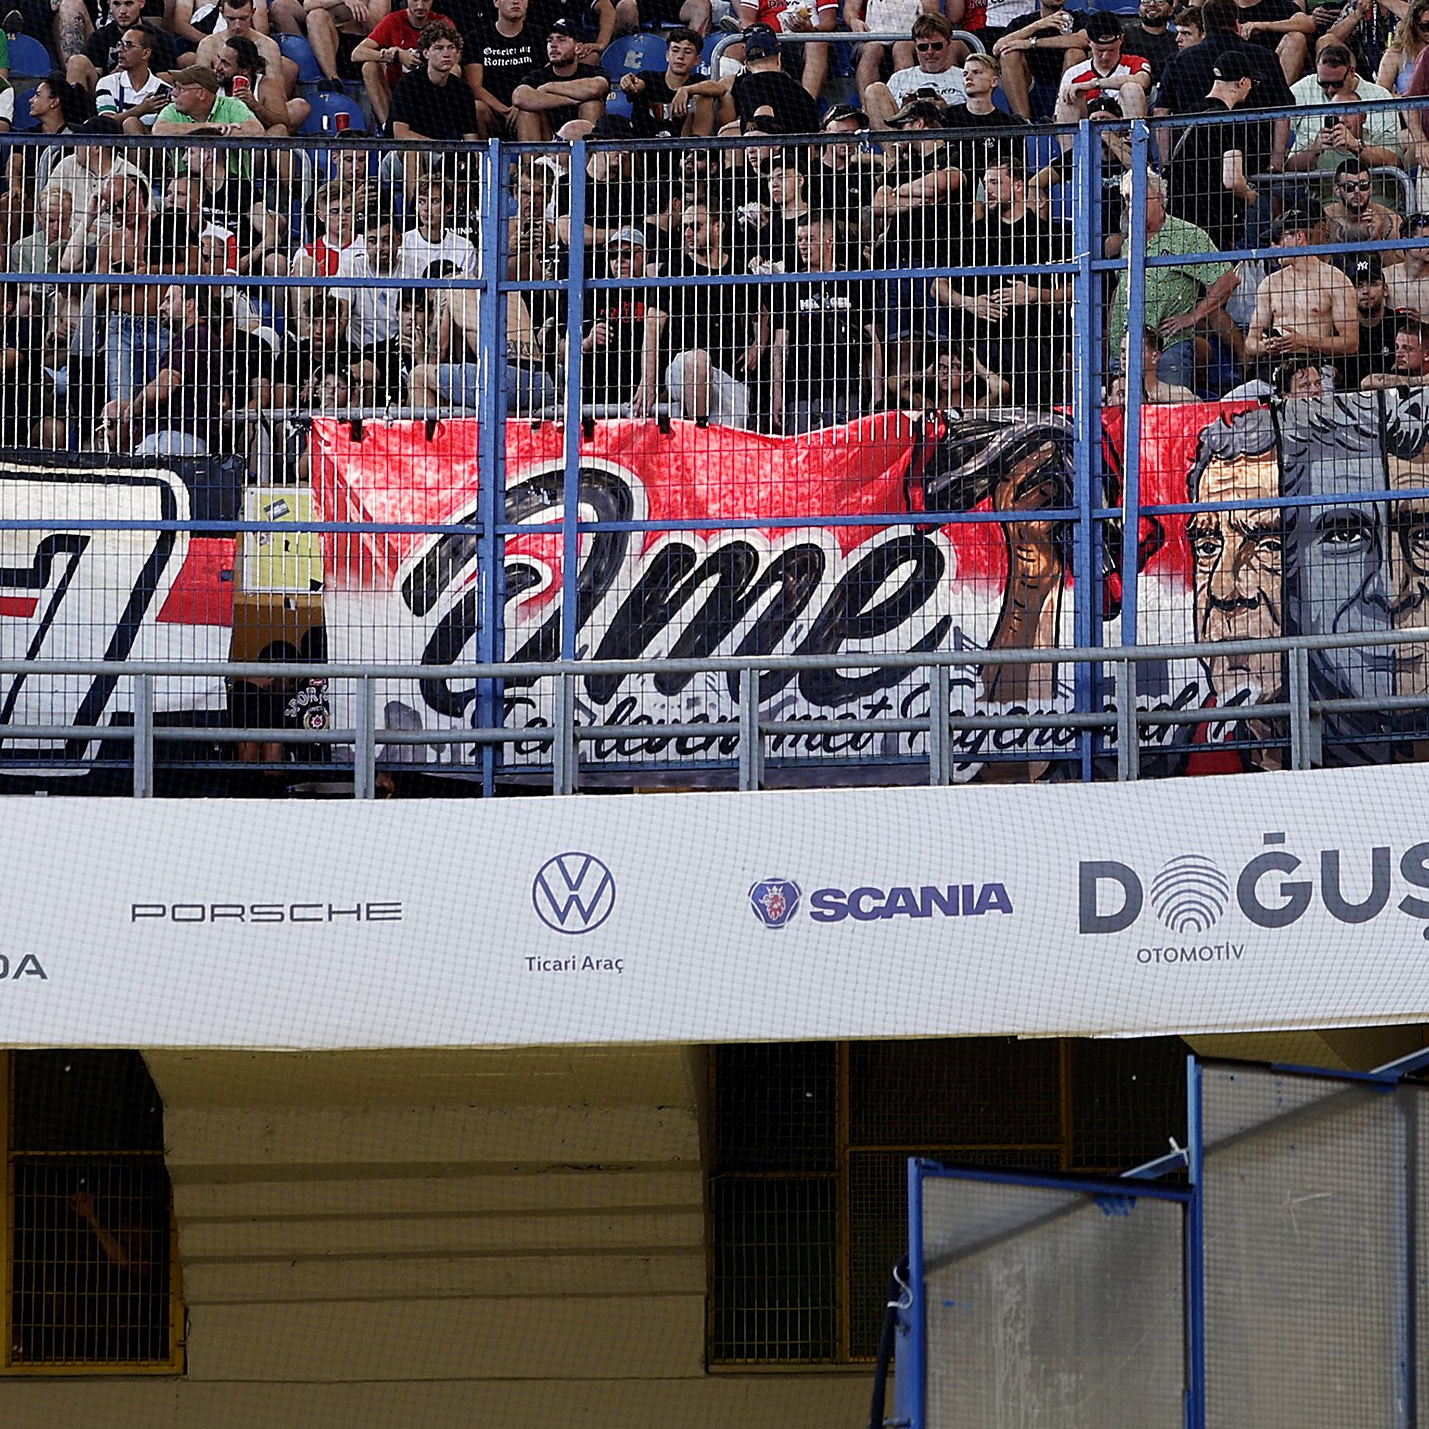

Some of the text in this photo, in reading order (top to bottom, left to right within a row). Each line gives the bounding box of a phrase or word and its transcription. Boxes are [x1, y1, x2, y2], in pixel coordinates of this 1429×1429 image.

[131, 901, 403, 923] PORSCHE
[810, 882, 1013, 923] SCANIA
[1136, 942, 1244, 964] OTOMOTİV
[525, 953, 624, 976] Ticari Araç
